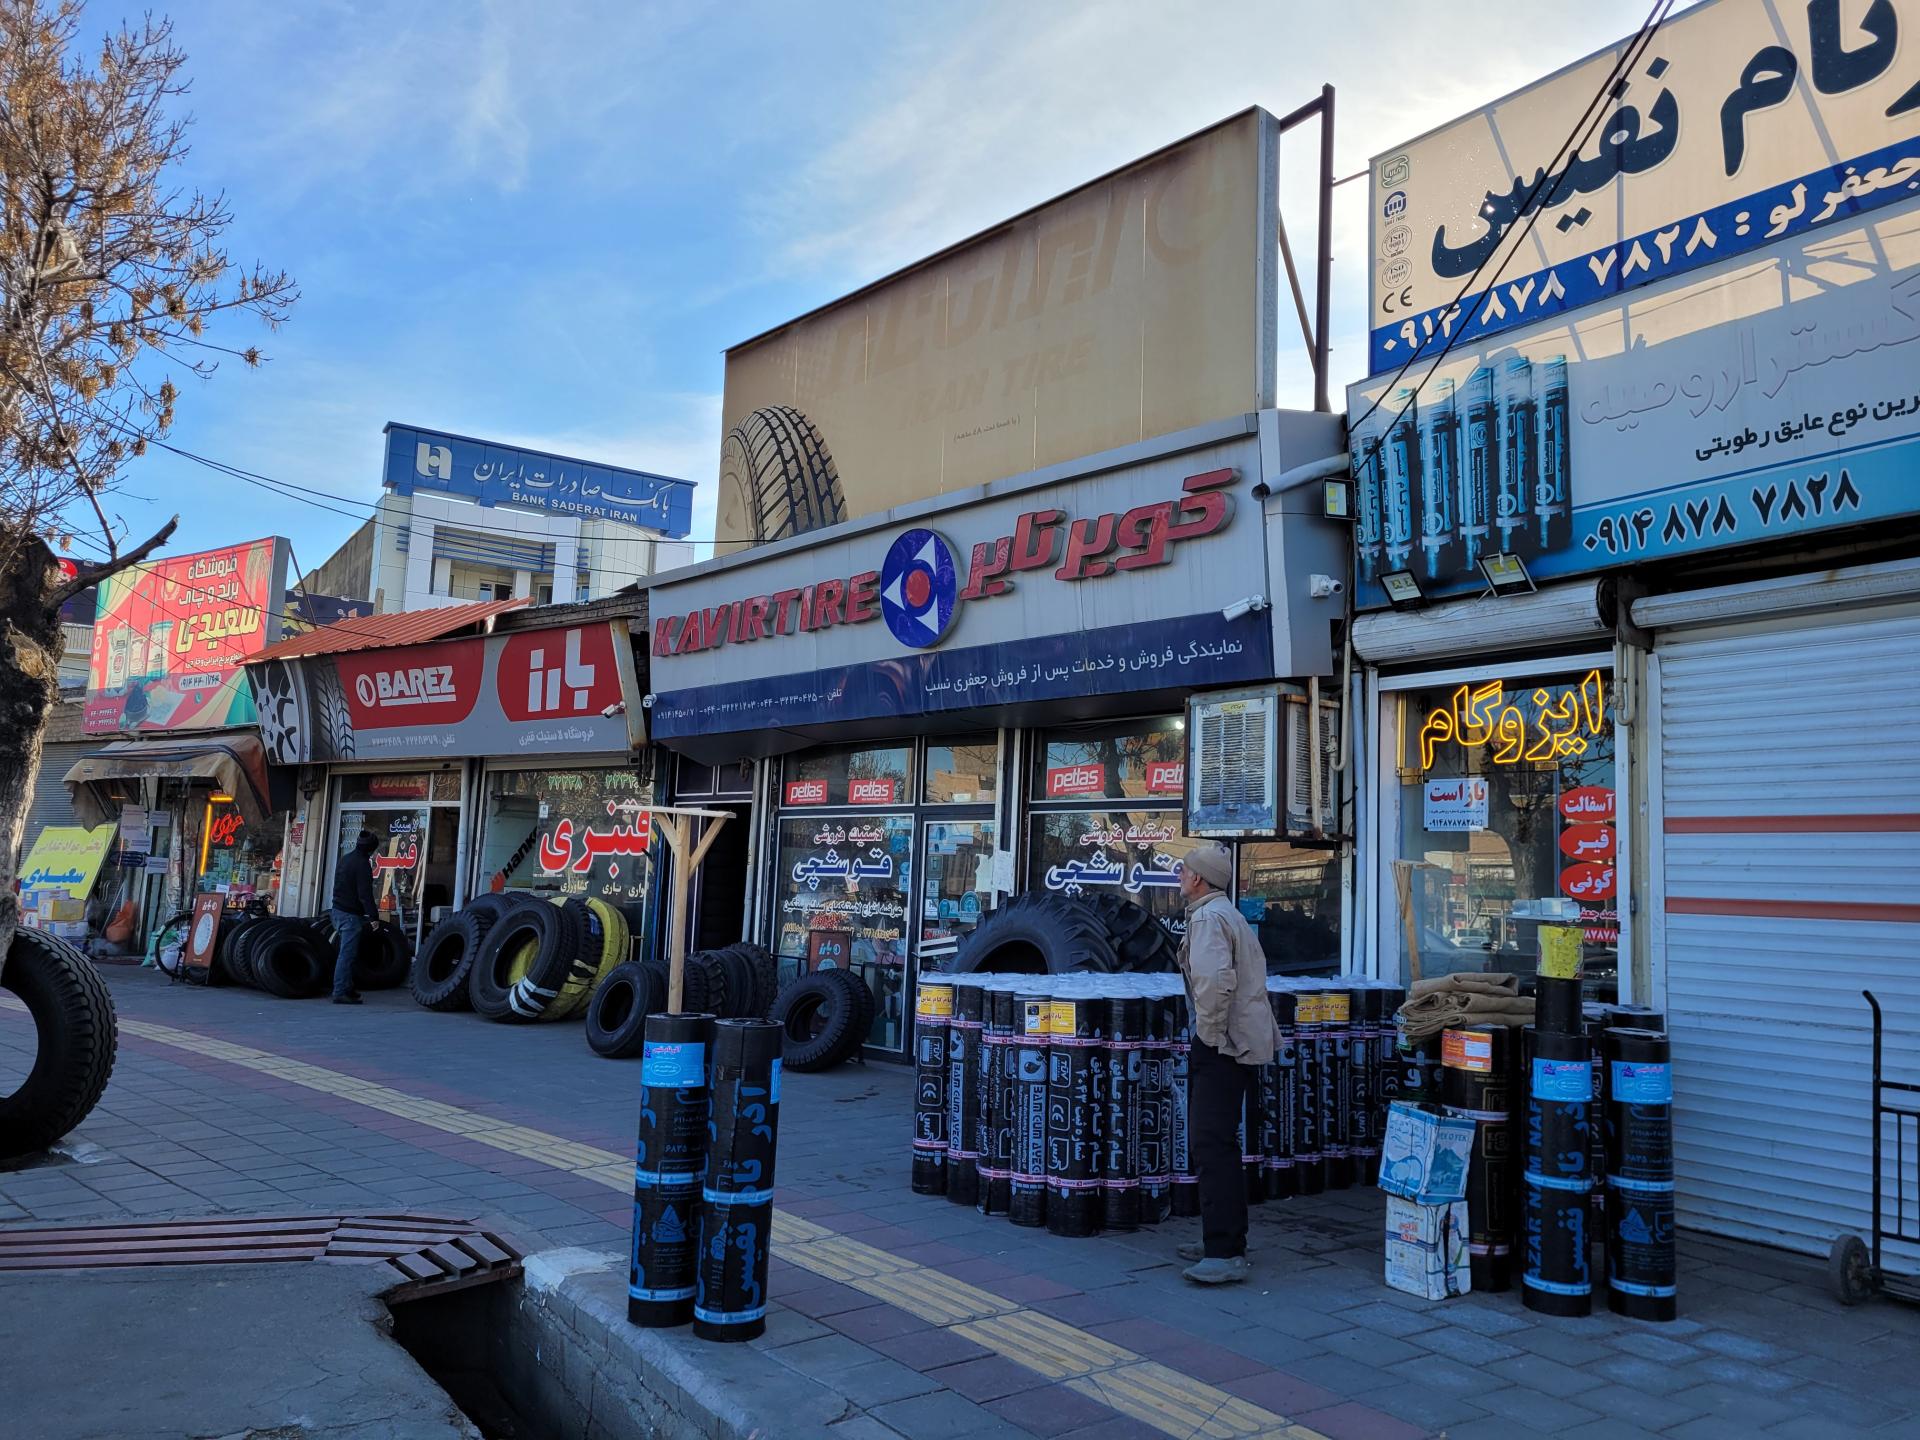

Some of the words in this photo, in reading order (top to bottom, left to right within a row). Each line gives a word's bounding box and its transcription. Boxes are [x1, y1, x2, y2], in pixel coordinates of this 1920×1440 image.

[1431, 56, 1680, 279] نفیس
[1382, 304, 1463, 353] ۰۹۱۴
[1480, 270, 1566, 327] ۸۷۸
[1587, 215, 1718, 289] ۷۸۲۸
[1773, 412, 1825, 444] عایق
[1826, 402, 1868, 436] نوع
[1694, 426, 1771, 462] رطوبتی
[473, 461, 525, 490] ایران
[525, 470, 601, 498] صادرات
[512, 491, 546, 507] BANK
[551, 498, 607, 518] SADERAT
[609, 508, 638, 523] IRAN
[1581, 507, 1656, 554] ۰۹۱۴
[1661, 498, 1737, 545] ۸۷۸
[1750, 469, 1863, 524] ۷۸۲۸
[186, 553, 238, 581] فروشگاه
[959, 509, 1066, 600] تایر
[178, 585, 206, 608] چای
[207, 587, 215, 604] و
[217, 579, 240, 604] برنج
[175, 604, 263, 654] سعیدی
[1072, 654, 1115, 673] خدمات
[1130, 649, 1174, 670] فروش
[1177, 638, 1243, 666] نمایندگی
[991, 664, 1028, 687] فروش
[1031, 663, 1042, 683] از
[1045, 664, 1069, 683] پس
[1118, 659, 1127, 672] و
[375, 665, 456, 703] BAREZ
[827, 687, 843, 701] تلفن
[924, 678, 951, 693] نسب
[953, 674, 989, 693] جعفری
[1420, 669, 1603, 770] ایزوگام
[536, 728, 562, 744] لاستیک
[563, 726, 594, 742] فروشگاه
[790, 782, 824, 802] petlas
[853, 780, 890, 802] petlas
[1053, 768, 1099, 793] petlas
[1429, 782, 1464, 802] است
[1463, 782, 1485, 807] باز
[1564, 793, 1615, 815] آسفالت
[539, 798, 651, 879] قنبری
[813, 823, 845, 845] فروشی
[848, 825, 885, 844] لاستیک
[1079, 820, 1124, 847] فروشی
[1125, 822, 1176, 850] لاستیک
[1573, 828, 1610, 855] قیر
[369, 834, 418, 878] قنبر
[560, 880, 590, 894] کشاورزی
[602, 881, 622, 896] باری
[1569, 869, 1613, 896] گونی
[1052, 1103, 1065, 1123] CE
